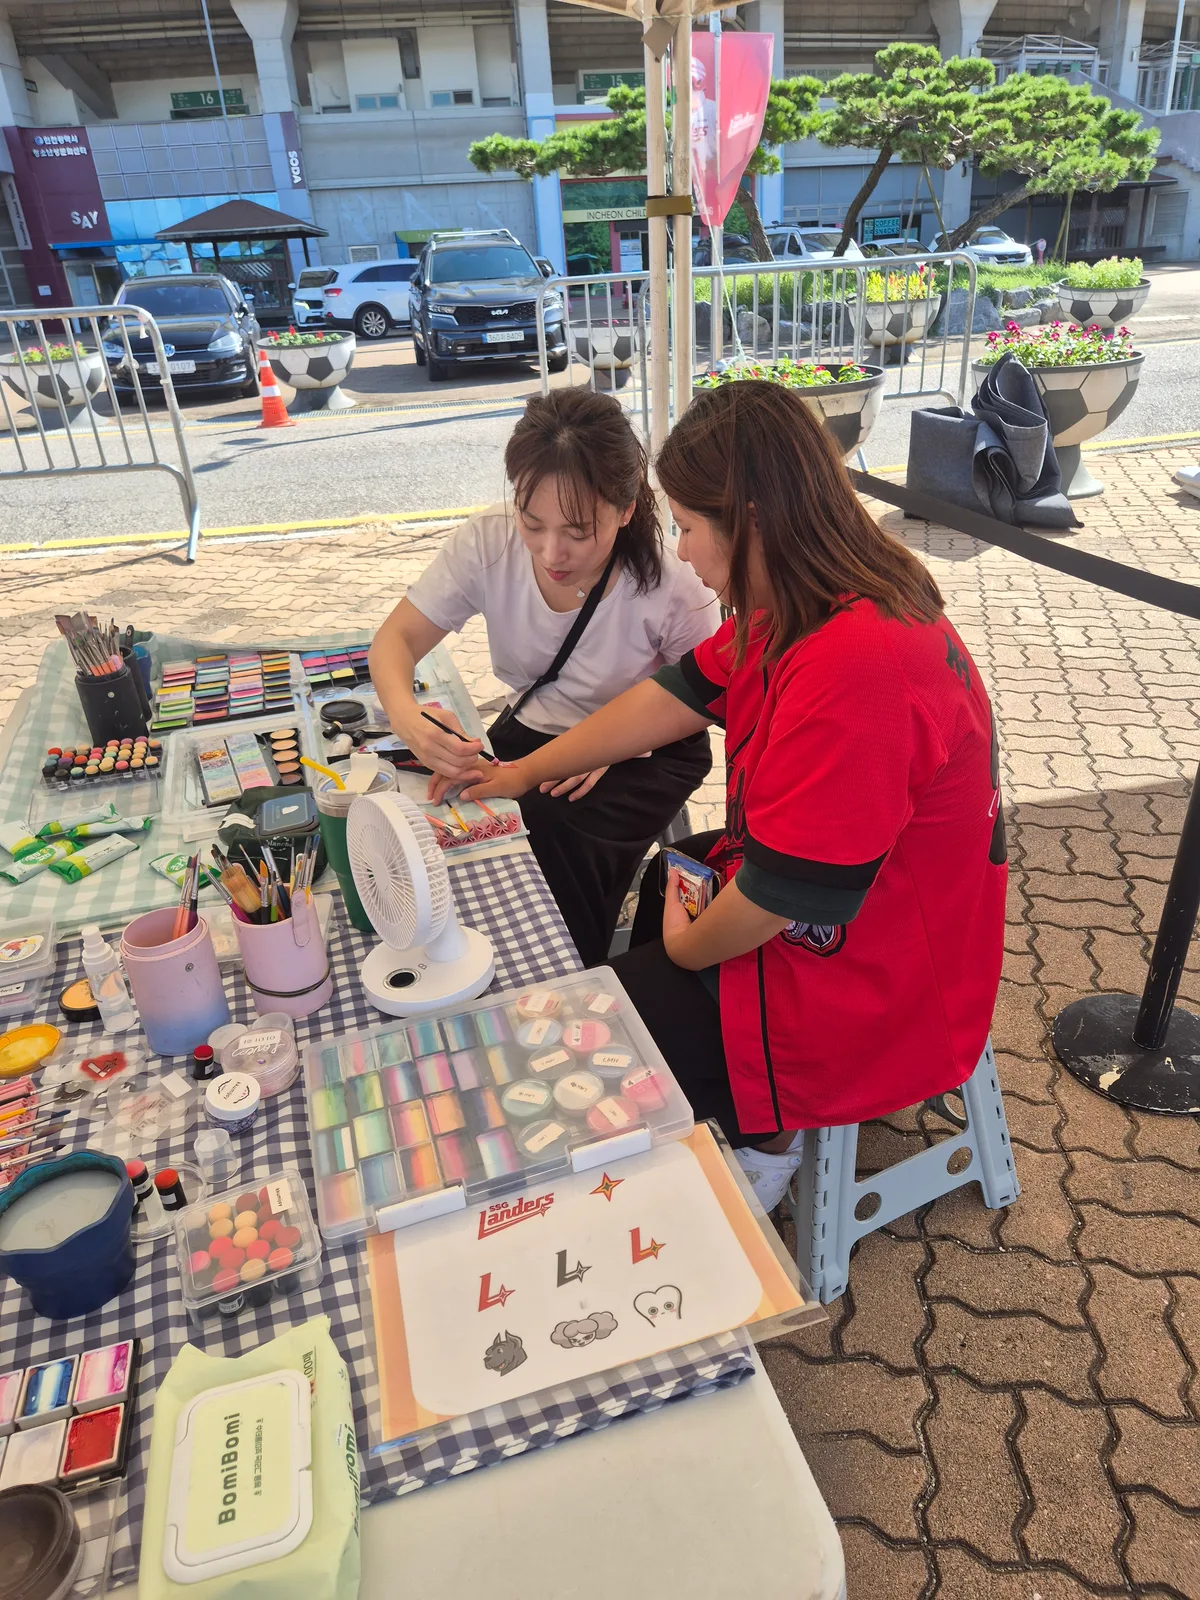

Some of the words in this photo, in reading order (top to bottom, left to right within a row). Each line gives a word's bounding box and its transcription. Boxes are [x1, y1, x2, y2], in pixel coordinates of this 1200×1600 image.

[610, 75, 623, 86] 15
[200, 92, 214, 105] 16
[43, 134, 79, 145] 인천광역시
[288, 150, 302, 184] SODA
[70, 210, 99, 229] SAY
[586, 210, 624, 220] INCHEON
[875, 219, 900, 227] COFFEE
[489, 1201, 509, 1212] SSG
[478, 1192, 555, 1240] Landers
[218, 1412, 241, 1525] BomiBomi
